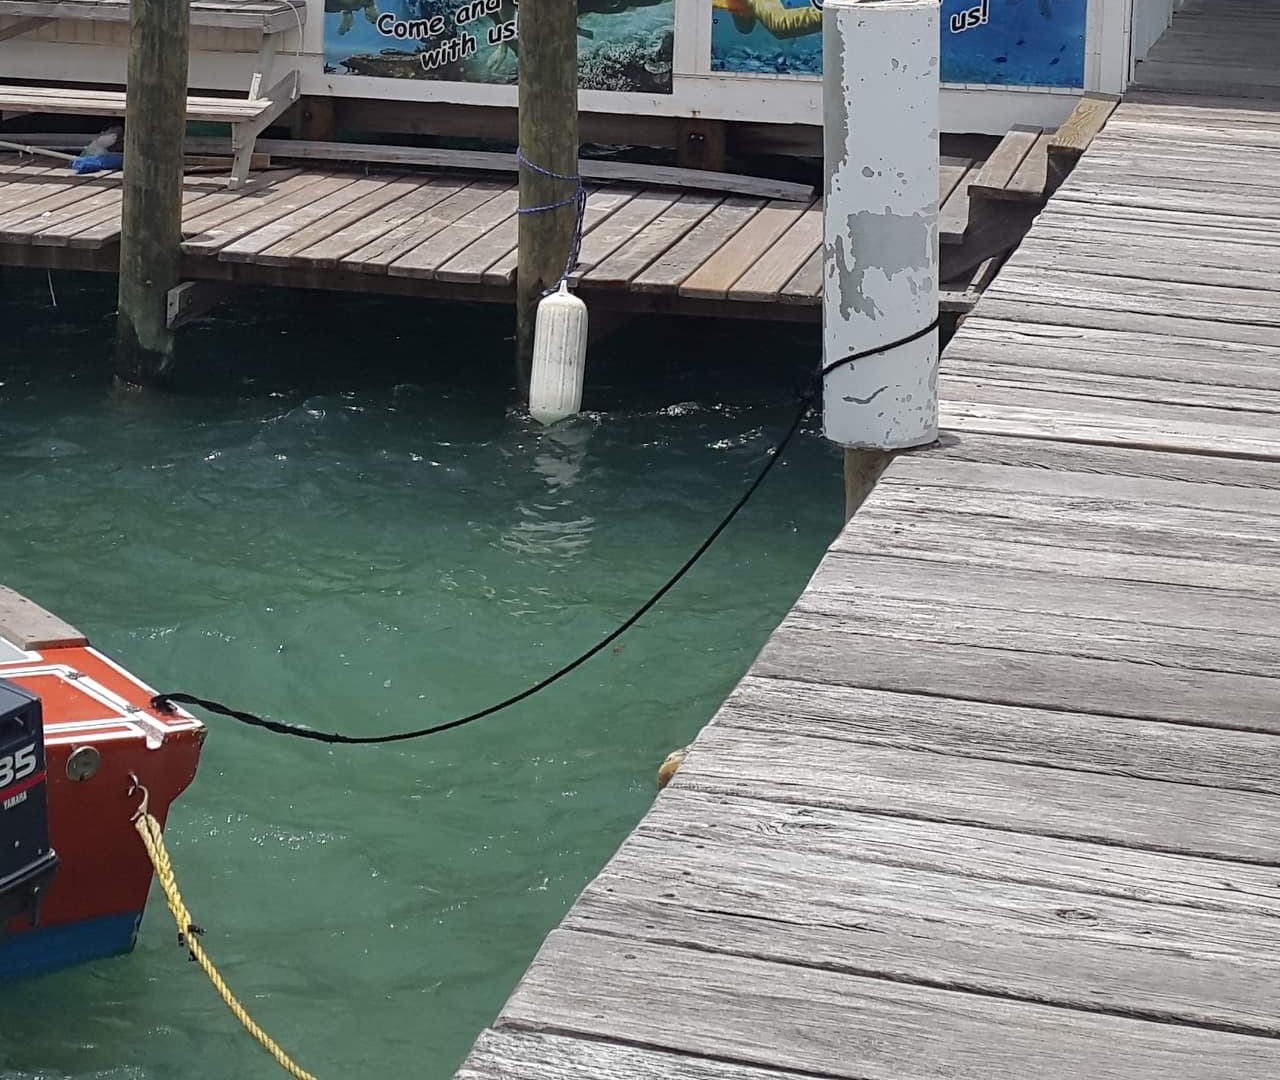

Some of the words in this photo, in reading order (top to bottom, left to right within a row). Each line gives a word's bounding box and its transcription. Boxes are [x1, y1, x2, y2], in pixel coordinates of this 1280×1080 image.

[376, 12, 445, 39] Come
[421, 32, 477, 70] with
[3, 790, 28, 810] YAMAHA
